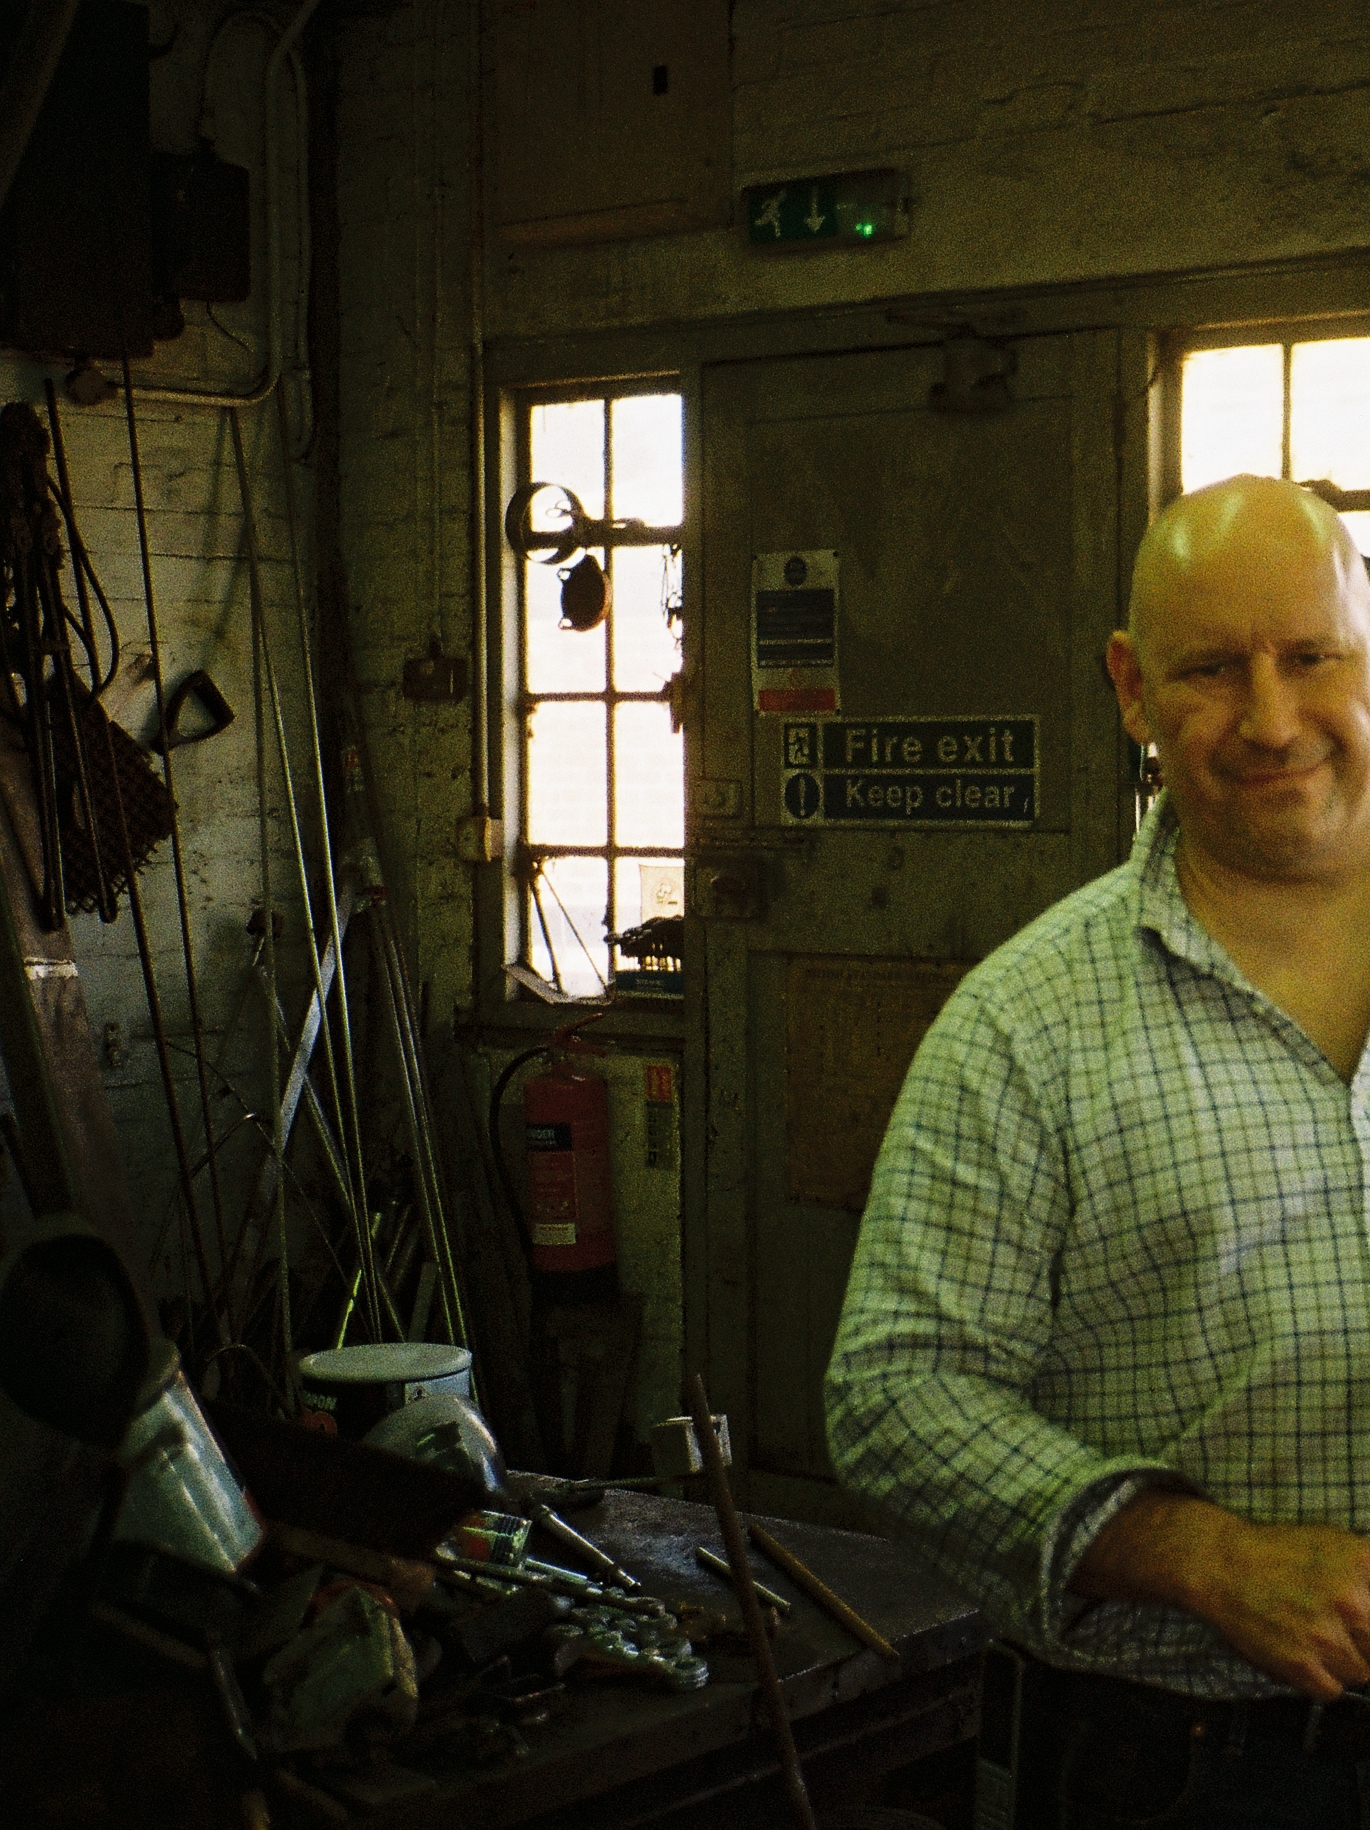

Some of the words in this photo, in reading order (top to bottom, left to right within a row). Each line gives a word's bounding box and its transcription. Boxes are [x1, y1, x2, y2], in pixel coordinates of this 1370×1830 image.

[846, 728, 923, 763] Fire
[937, 727, 1015, 763] exit
[846, 778, 923, 815] Keep
[935, 777, 1016, 809] clear
